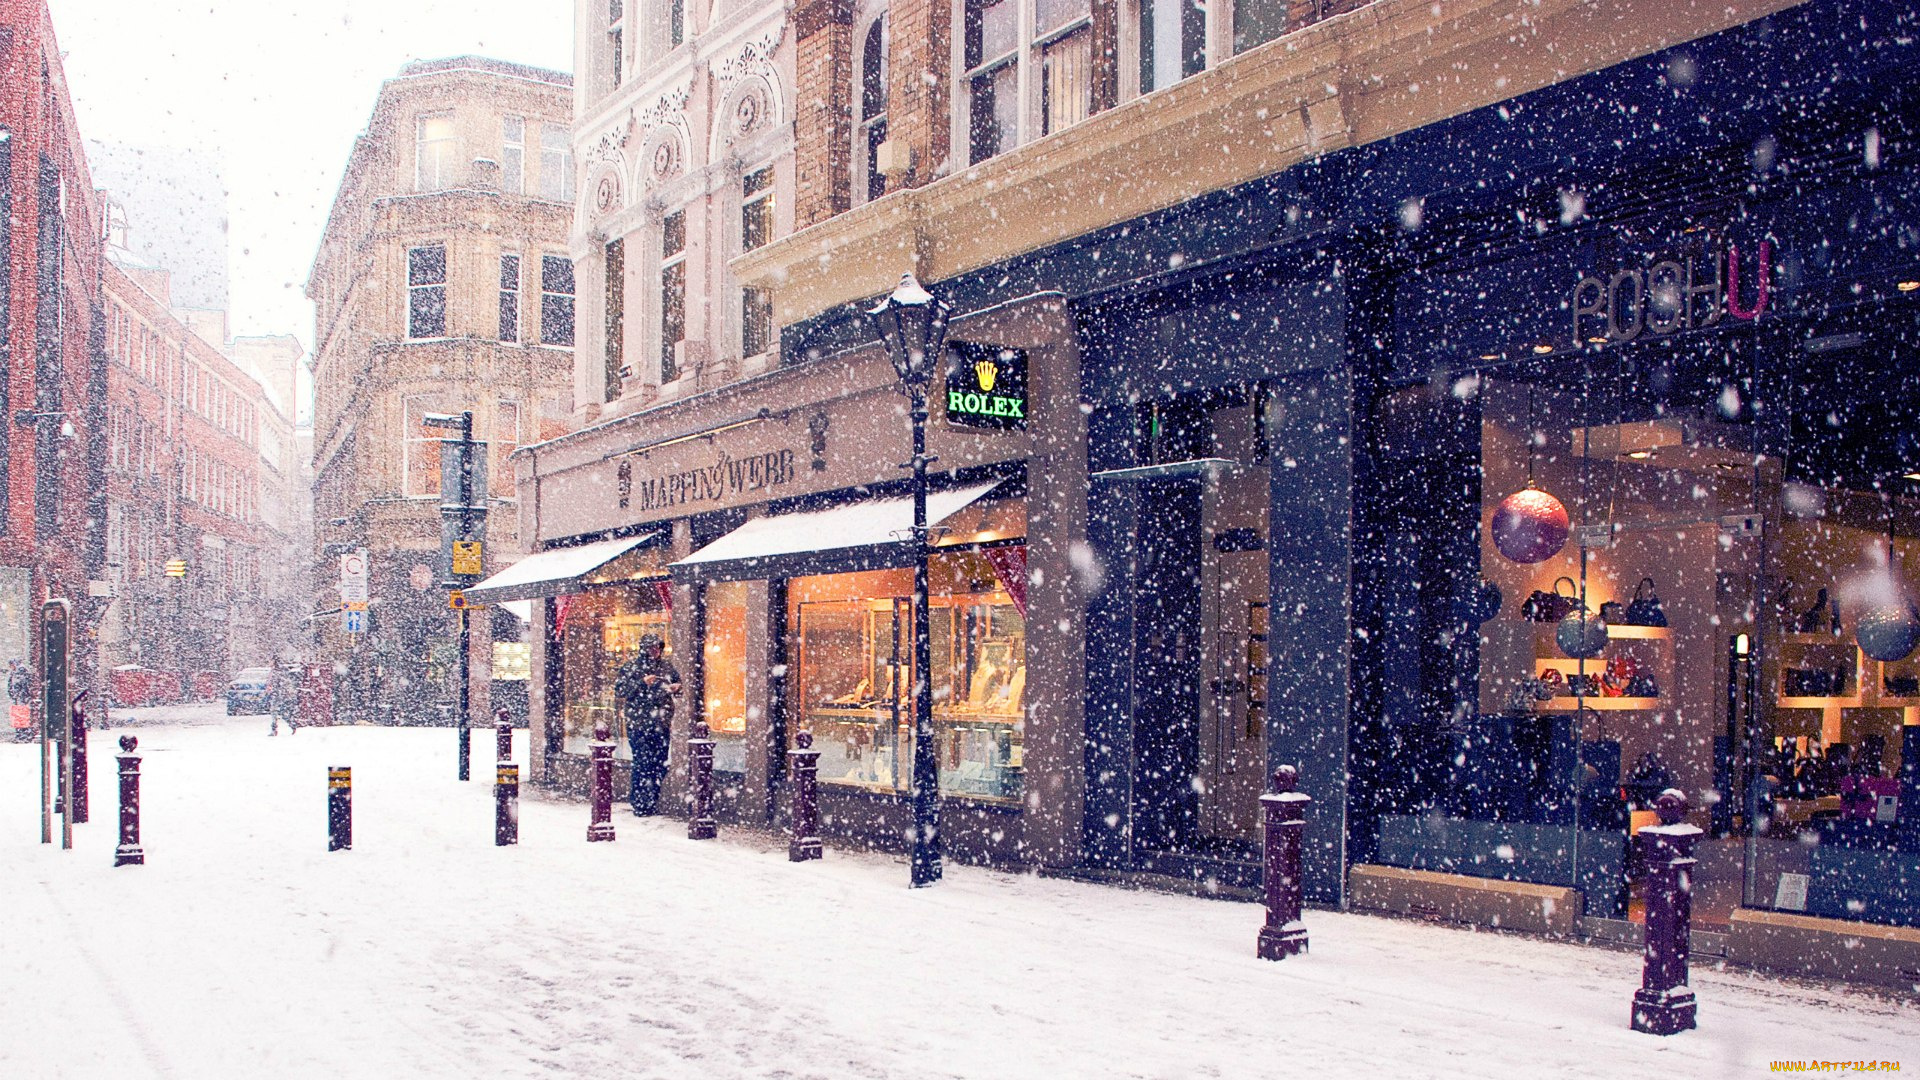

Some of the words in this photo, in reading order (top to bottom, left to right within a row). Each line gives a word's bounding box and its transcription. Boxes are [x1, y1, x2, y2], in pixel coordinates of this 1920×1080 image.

[949, 392, 1024, 418] ROLEX
[640, 467, 715, 511] MAPPIN
[728, 449, 795, 493] WEBB
